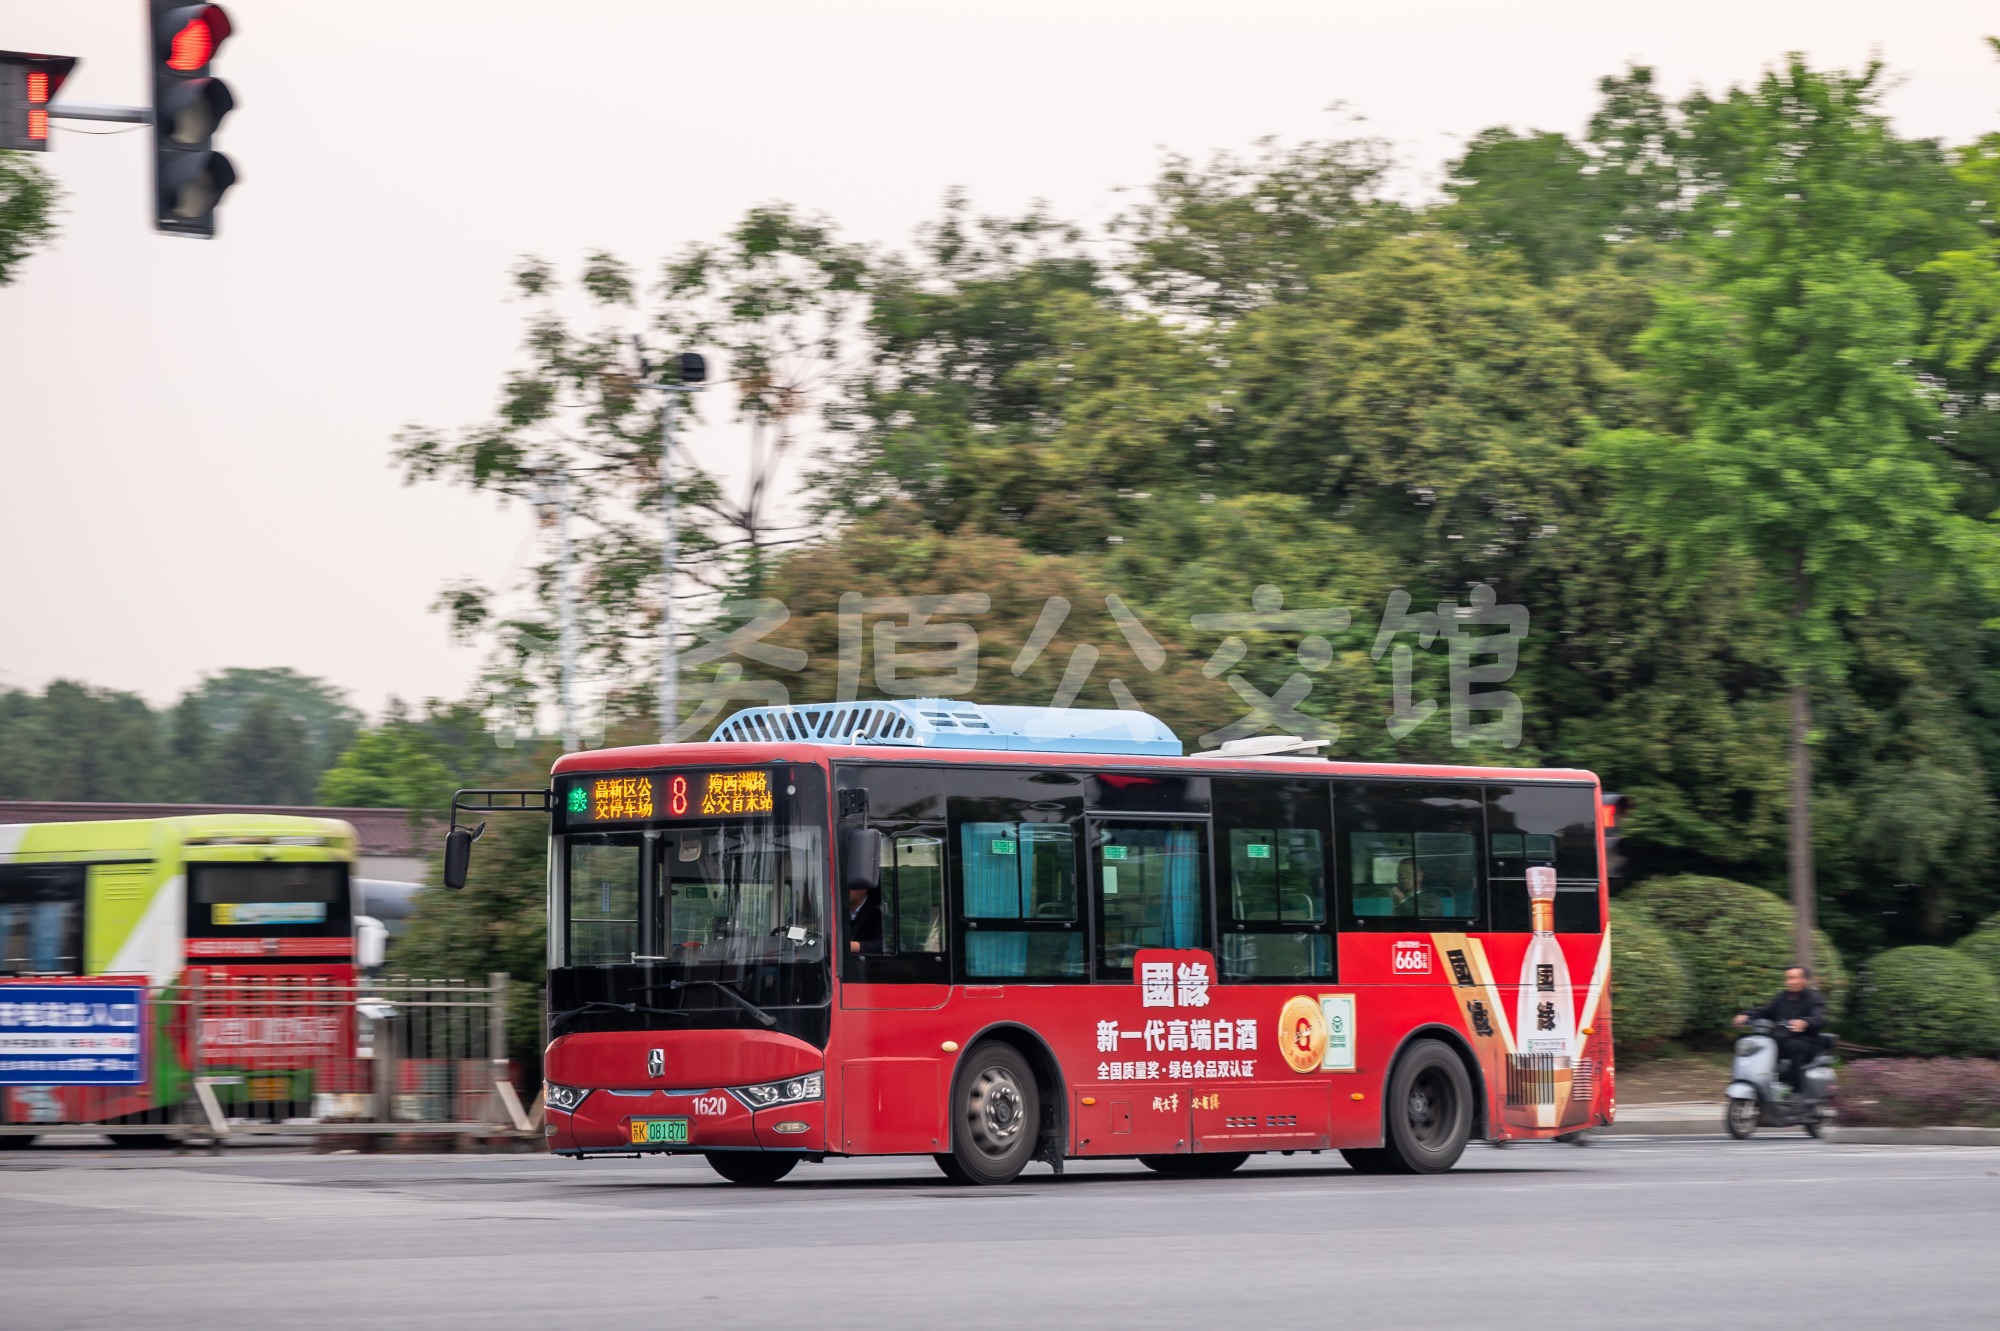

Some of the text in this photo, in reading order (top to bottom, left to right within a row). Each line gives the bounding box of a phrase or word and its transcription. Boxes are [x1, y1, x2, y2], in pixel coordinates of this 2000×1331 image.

[595, 778, 653, 799] 高新区公
[708, 772, 768, 794] 瘦西湖路
[672, 776, 688, 815] 8
[702, 791, 773, 815] 公交首末站
[595, 801, 653, 820] 交停车场
[1395, 950, 1422, 970] 668
[1096, 1018, 1258, 1052] 新一代高端白酒
[692, 1096, 727, 1116] 1620
